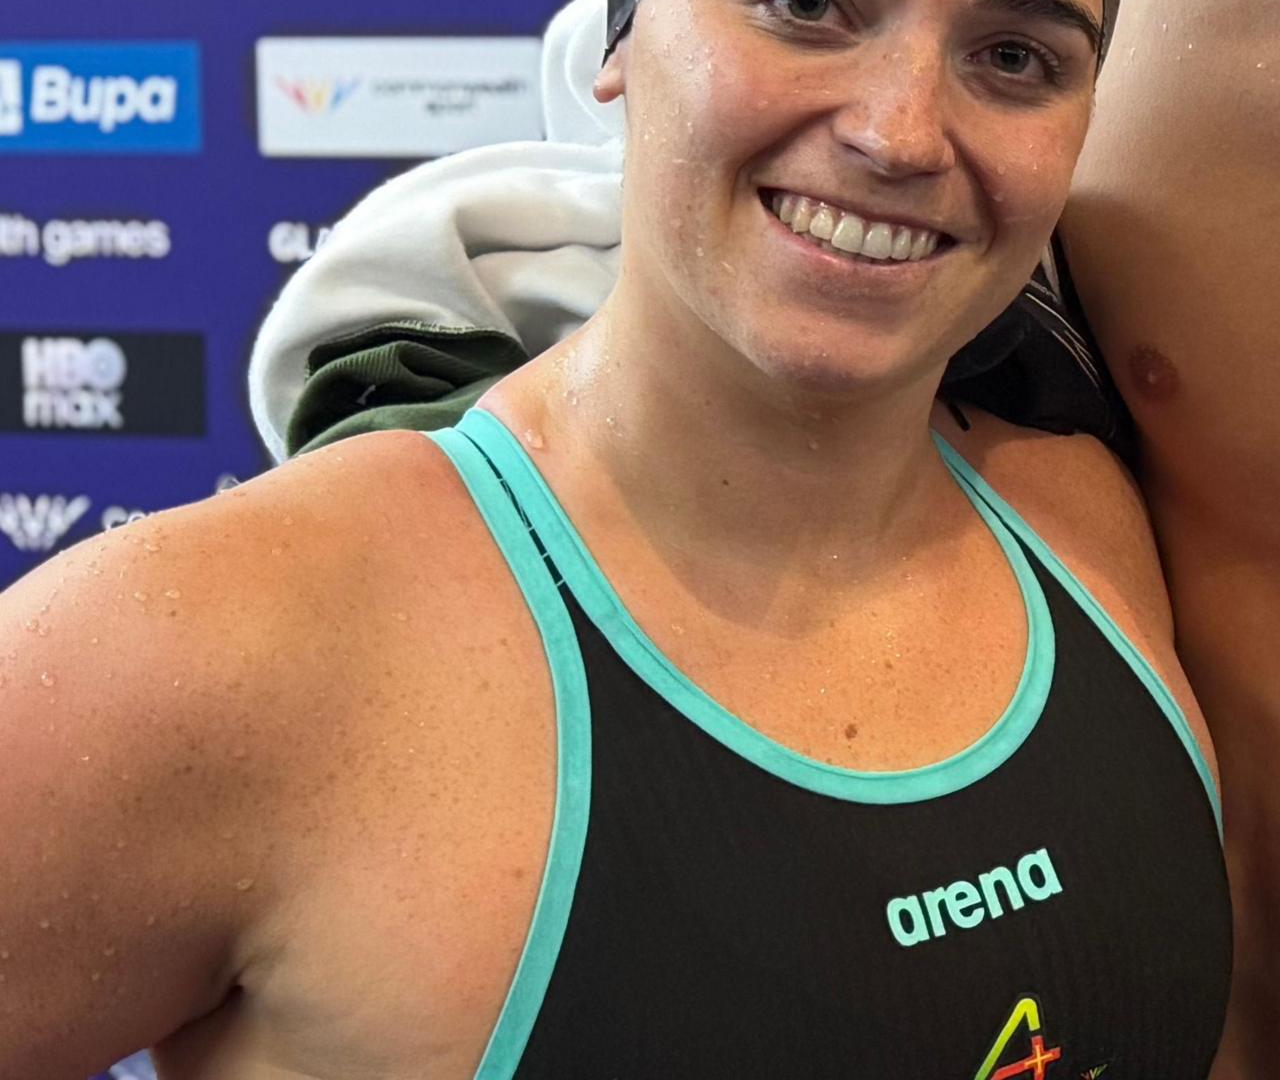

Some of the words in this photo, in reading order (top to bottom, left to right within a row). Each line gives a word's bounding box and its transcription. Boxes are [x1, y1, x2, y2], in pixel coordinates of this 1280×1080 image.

[31, 65, 178, 133] Bupa
[42, 219, 171, 265] games
[22, 337, 127, 391] HBO
[23, 389, 123, 429] max
[886, 847, 1063, 947] arena
